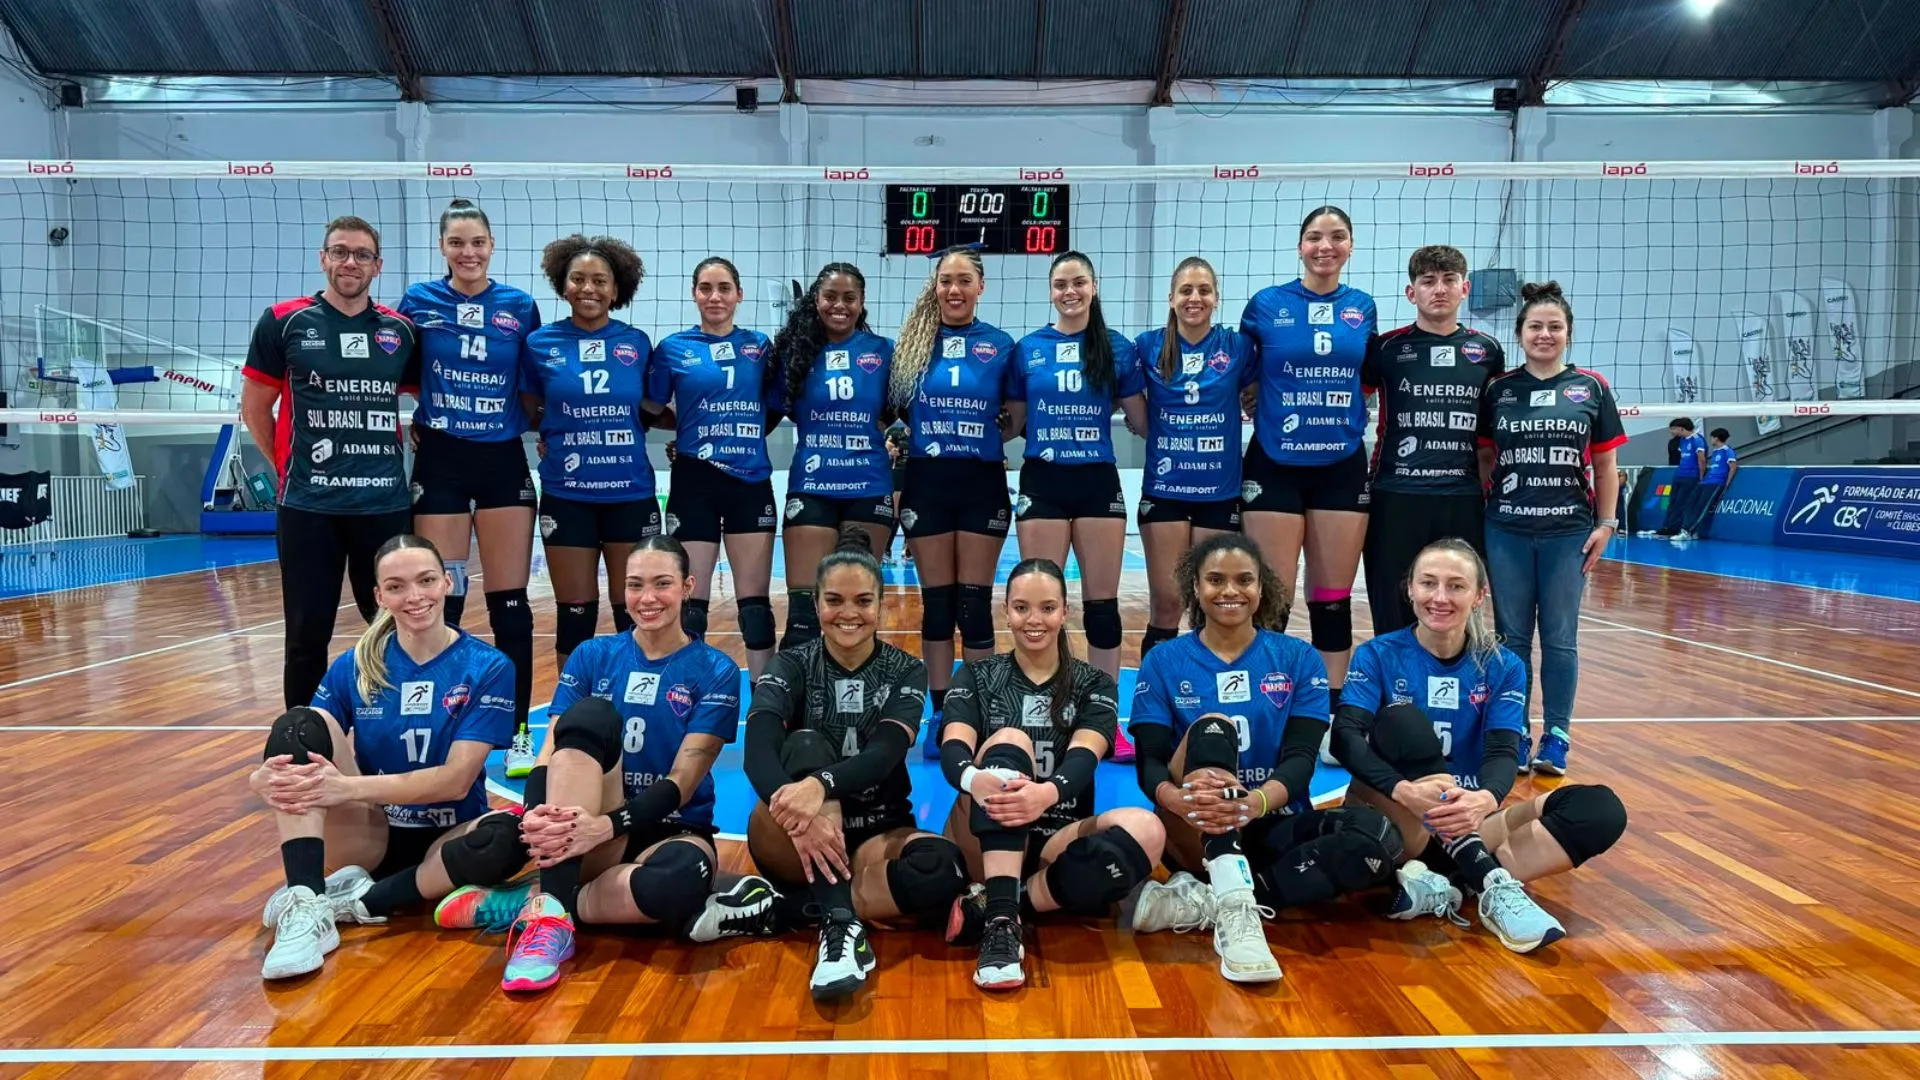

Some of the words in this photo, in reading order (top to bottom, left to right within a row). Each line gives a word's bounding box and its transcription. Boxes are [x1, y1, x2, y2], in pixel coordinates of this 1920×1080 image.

[912, 191, 928, 218] 0
[1033, 191, 1049, 218] 0
[905, 226, 935, 251] 00
[1026, 226, 1056, 252] 00
[458, 334, 488, 362] 14
[1313, 331, 1334, 356] 6
[444, 369, 507, 385] ENERBAU
[720, 365, 736, 390] 7
[947, 365, 960, 387] 1
[1295, 366, 1356, 379] ENERBAU
[163, 369, 216, 393] RAPINI
[325, 380, 397, 396] ENERBAU
[578, 369, 611, 395] 12
[825, 376, 854, 401] 18
[1053, 369, 1083, 393] 10
[1183, 381, 1201, 405] 3
[1296, 390, 1324, 407] BRASIL
[1328, 393, 1351, 405] TNT
[1413, 384, 1481, 400] ENERBAU
[444, 394, 472, 412] BRASIL
[478, 399, 505, 412] TNT
[709, 401, 761, 412] ENERBAU
[929, 397, 988, 411] ENERBAU
[1048, 404, 1102, 416] ENERBAU
[308, 409, 326, 428] SUL
[328, 410, 363, 429] BRASIL
[573, 405, 631, 418] ENERBAU
[1169, 412, 1225, 425] ENERBAU
[454, 421, 487, 431] ADAMI
[1305, 417, 1336, 426] ADAMI
[1397, 412, 1413, 428] SUL
[1414, 411, 1446, 428] BRASIL
[1451, 414, 1476, 429] TNT
[1510, 419, 1588, 435] ENERBAU
[739, 426, 760, 437] TNT
[933, 421, 957, 435] BRASIL
[960, 424, 983, 436] TNT
[1036, 428, 1049, 442] SUL
[1050, 427, 1074, 441] BRASIL
[1076, 429, 1099, 440] TNT
[577, 431, 603, 446] BRASIL
[607, 431, 633, 443] TNT
[819, 434, 844, 448] BRASIL
[1169, 436, 1195, 452] BRASIL
[1199, 437, 1224, 451] TNT
[341, 443, 380, 455] ADAMI
[718, 445, 745, 455] ADAMI
[1424, 440, 1459, 450] ADAMI
[586, 456, 617, 465] ADAMI
[826, 458, 855, 467] ADAMI
[1514, 446, 1547, 464] BRASIL
[1552, 449, 1580, 465] TNT
[1177, 462, 1208, 471] ADAMI
[1525, 477, 1561, 488] ADAMI
[1843, 485, 1892, 500] FORMAÇÃO
[1892, 487, 1906, 499] DE
[1499, 505, 1576, 517] FRAMEPORT
[1833, 505, 1869, 529] CBC
[1265, 683, 1291, 692] NAPOLI
[623, 716, 646, 754] 8
[841, 726, 860, 757] 4
[1433, 720, 1453, 757] 5
[400, 728, 432, 764] 17
[1034, 740, 1056, 779] 5
